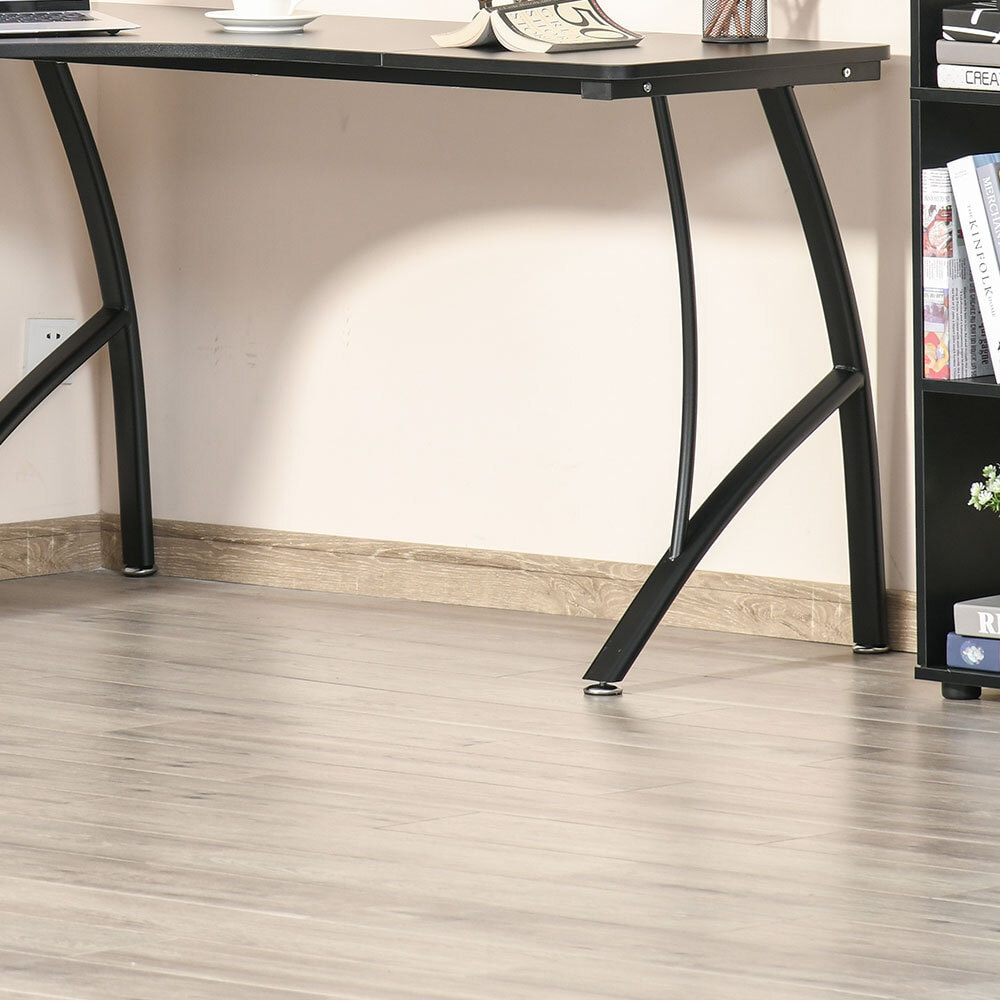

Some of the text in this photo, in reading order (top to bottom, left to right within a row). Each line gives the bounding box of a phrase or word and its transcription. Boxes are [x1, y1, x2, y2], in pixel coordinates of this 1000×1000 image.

[965, 71, 1000, 87] CREA
[969, 220, 993, 297] KINFOLK
[977, 611, 1000, 634] R
